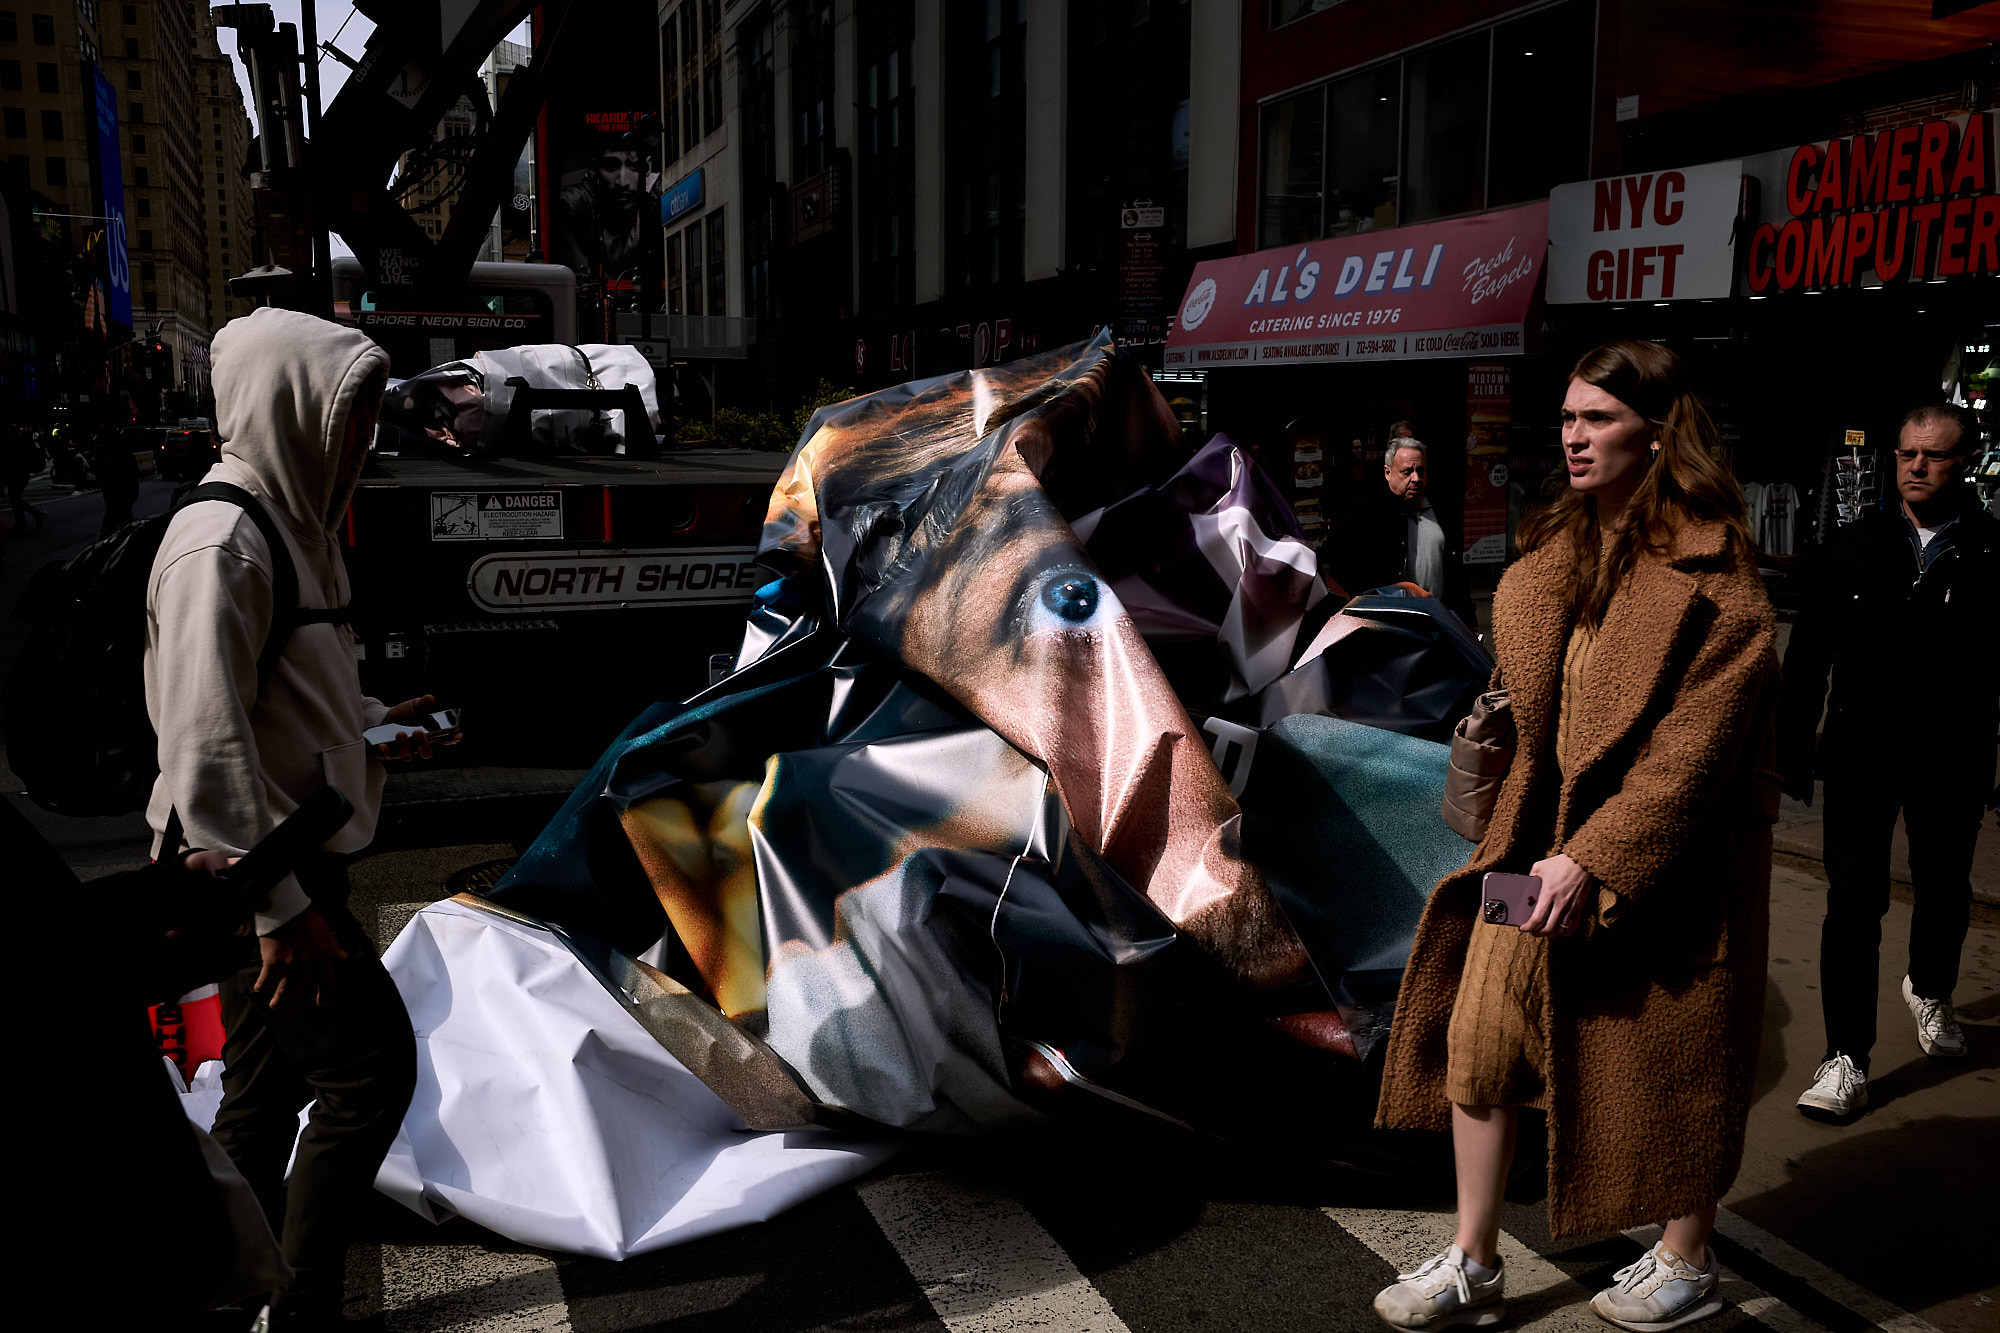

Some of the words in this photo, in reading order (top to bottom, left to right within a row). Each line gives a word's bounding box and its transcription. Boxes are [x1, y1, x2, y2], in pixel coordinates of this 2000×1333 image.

[1787, 112, 1989, 218] CAMERA
[1593, 171, 1685, 232] NYC
[380, 248, 401, 258] WE
[1747, 195, 2000, 295] COMPUTER
[379, 257, 419, 267] HANG
[384, 266, 402, 276] TO
[1461, 236, 1516, 293] Fresh
[380, 275, 414, 285] LIVE.
[1244, 246, 1321, 309] AL'S
[1334, 243, 1446, 299] DELI
[1470, 255, 1533, 305] Bagels
[1586, 244, 1684, 301] GIFT
[365, 315, 417, 326] SHORE
[421, 316, 464, 327] NEON
[466, 317, 501, 328] SIGN
[1249, 315, 1315, 333] CATERING
[1317, 312, 1362, 329] SINCE
[1366, 308, 1402, 325] 1976
[1415, 337, 1425, 352] ICE
[1426, 336, 1442, 351] COLD
[1480, 333, 1498, 348] SOLD
[1500, 331, 1520, 347] HERE
[1166, 351, 1185, 364] CATERING
[1262, 346, 1283, 359] SEATING
[1283, 344, 1311, 358] AVAILABLE
[1312, 343, 1339, 356] UPSTAIRS!
[1468, 373, 1510, 384] MIDTOWN
[1473, 384, 1505, 395] SLIDER
[505, 495, 555, 508] DANGER
[494, 566, 624, 596] NORTH
[636, 563, 756, 592] SHORE
